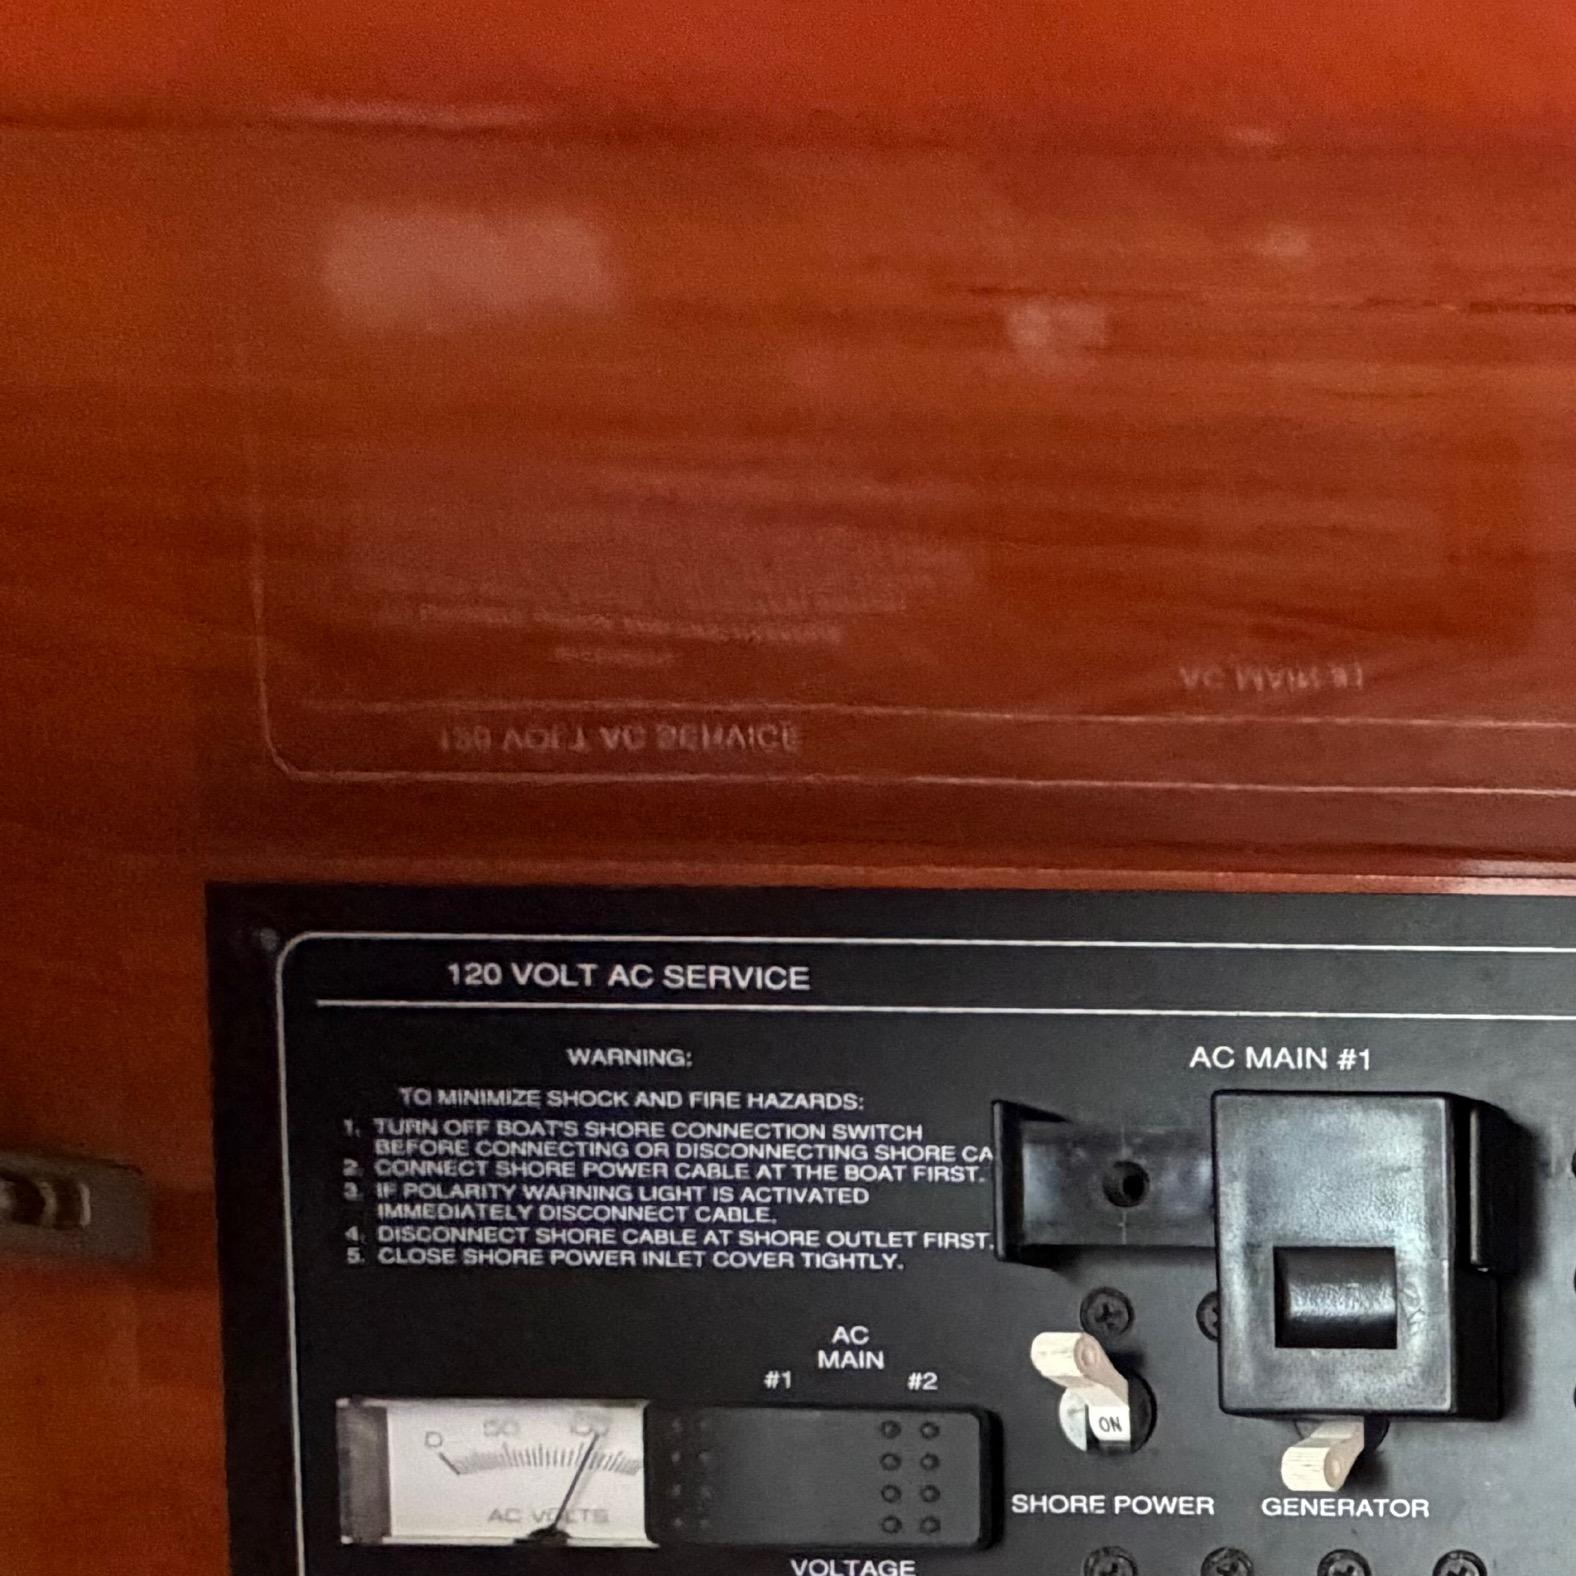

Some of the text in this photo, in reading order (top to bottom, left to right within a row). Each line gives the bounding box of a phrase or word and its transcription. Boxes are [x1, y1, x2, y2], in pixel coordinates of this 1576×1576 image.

[447, 962, 811, 990] 120 VOLT AC SERVICE
[566, 1047, 693, 1067] WARNING:
[1188, 1045, 1370, 1071] AC MAIN #1
[400, 1087, 865, 1110] TO MINIMIZE SHOCK AND FIRE HAZARDS:
[374, 1118, 439, 1135] TURN
[442, 1119, 490, 1135] OFF
[584, 1120, 666, 1138] SHORE
[670, 1121, 826, 1140] CONNECTION
[831, 1123, 924, 1141] SWITCH
[377, 1247, 904, 1270] CLOSE SHORE POWER INLET COVER TIGHTLY.
[831, 1325, 870, 1345] AC
[817, 1350, 885, 1369] MAIN
[763, 1370, 792, 1389] #1
[907, 1371, 938, 1390] #2
[1098, 1416, 1122, 1433] ON
[1011, 1493, 1216, 1515] SHORE POWER
[1260, 1497, 1430, 1518] GENERATOR
